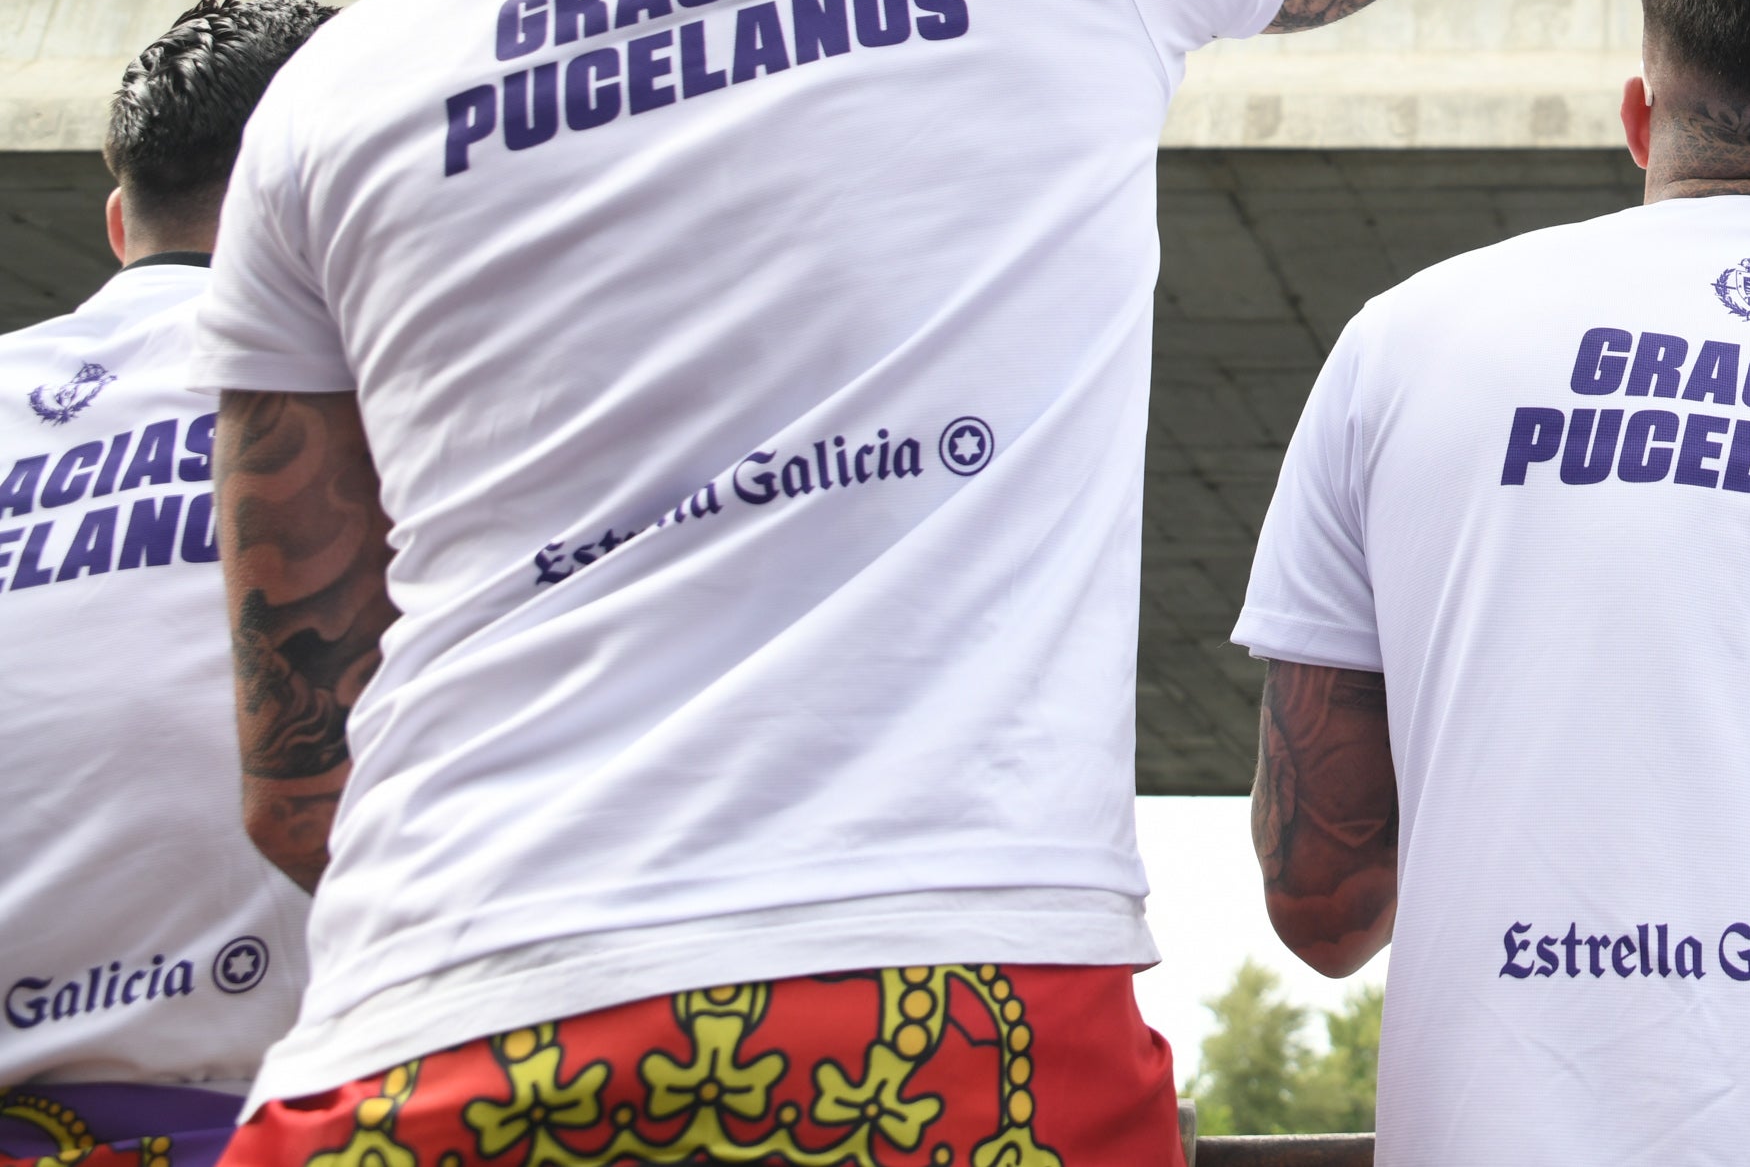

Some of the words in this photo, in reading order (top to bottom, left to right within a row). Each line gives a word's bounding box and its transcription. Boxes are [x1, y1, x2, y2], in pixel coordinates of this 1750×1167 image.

[733, 428, 924, 506] Galicia
[1499, 921, 1706, 980] Estrella
[4, 954, 195, 1029] Galicia
